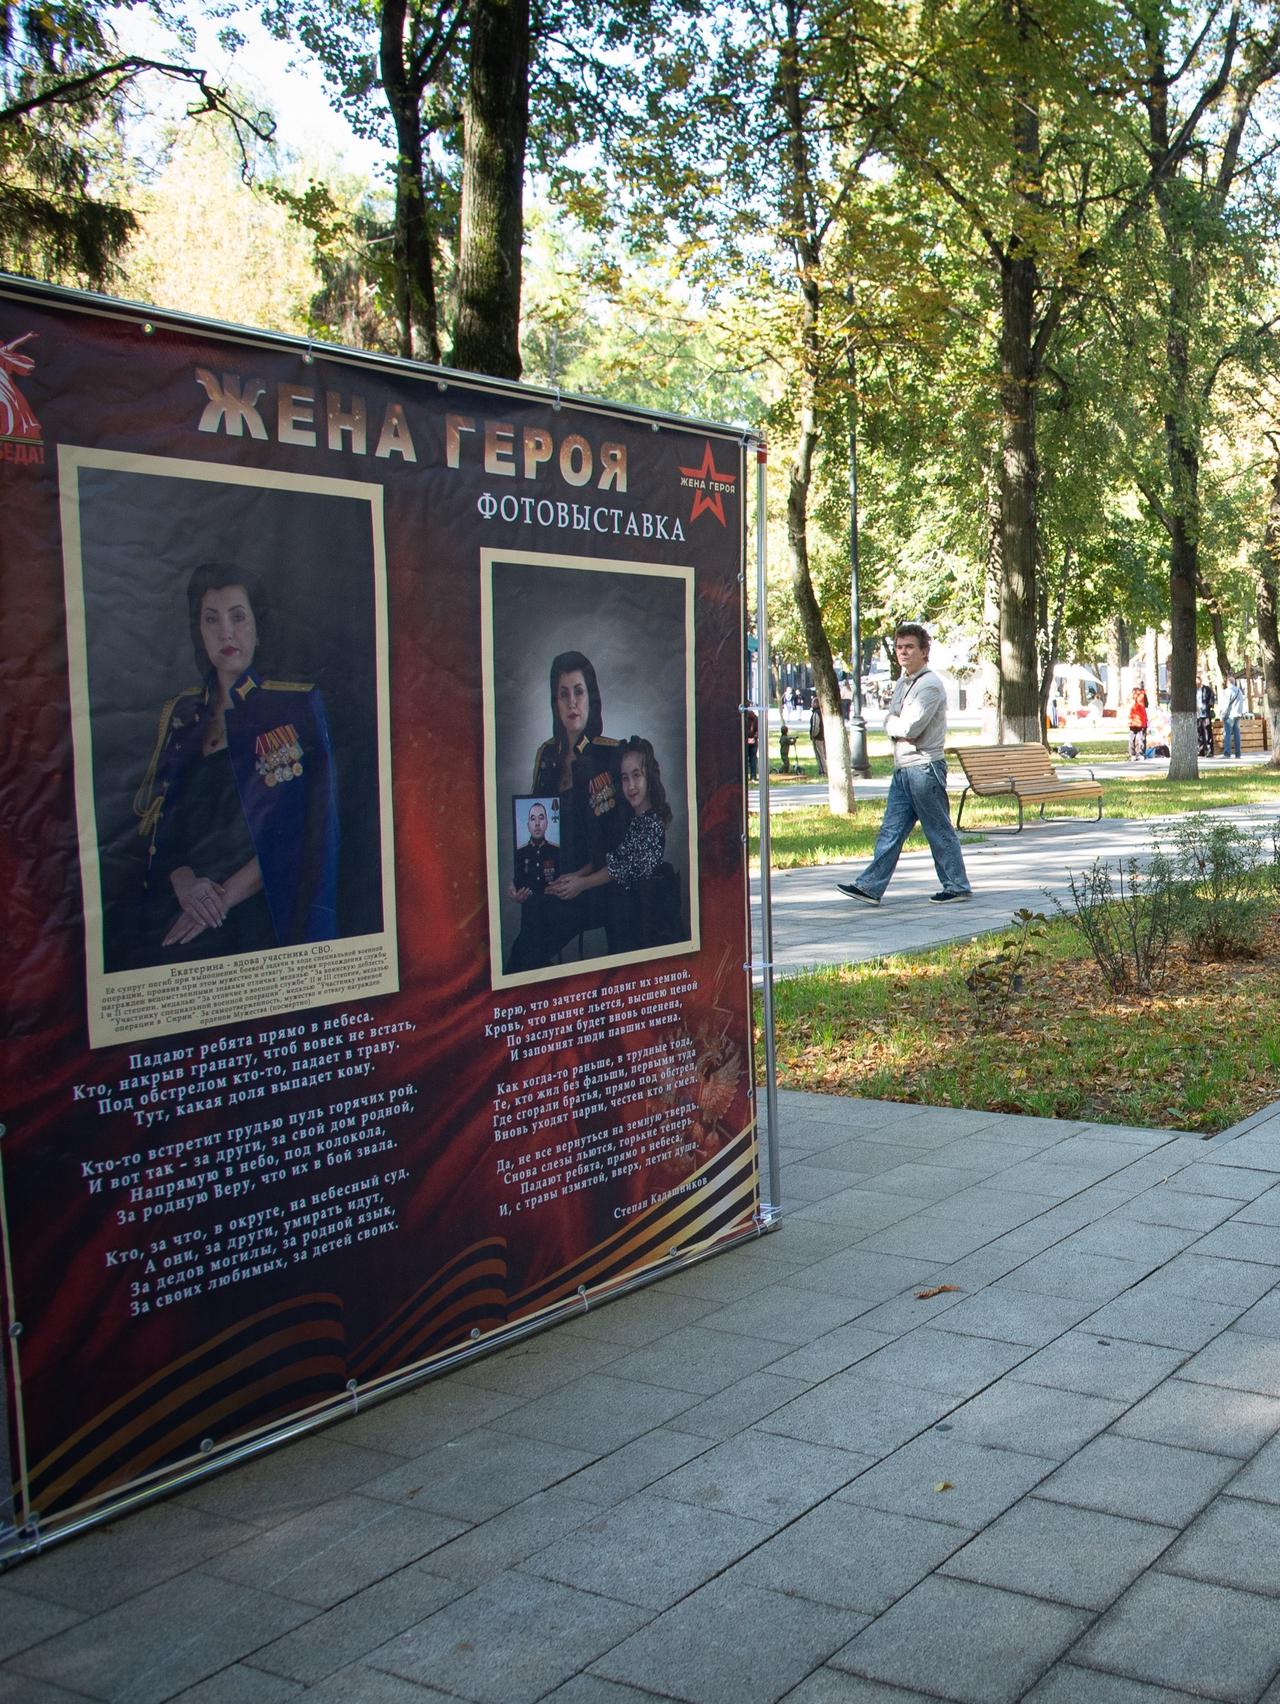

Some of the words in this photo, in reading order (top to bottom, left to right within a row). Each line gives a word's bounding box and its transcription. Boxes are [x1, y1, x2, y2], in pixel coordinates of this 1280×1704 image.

[195, 367, 417, 462] ЖЕНА
[445, 415, 629, 493] ГЕРОЯ
[680, 476, 706, 489] ЖЕНА
[709, 481, 735, 494] ГЕРОЯ
[477, 492, 687, 542] ФОТОВЫСТАВКА
[116, 983, 145, 993] супруг
[170, 963, 224, 977] Екатерина
[233, 957, 259, 966] вдова
[262, 950, 308, 963] участника
[527, 1015, 546, 1026] что
[549, 1006, 584, 1022] нынче
[627, 988, 666, 1004] высшею
[669, 980, 697, 995] ценой
[529, 999, 548, 1010] что
[552, 989, 597, 1006] зачтется
[600, 980, 636, 996] подвиг
[639, 978, 651, 988] их
[128, 1047, 194, 1069] Падают
[199, 1035, 253, 1059] ребята
[258, 1025, 305, 1045] прямо
[311, 1022, 318, 1032] в
[323, 1012, 373, 1030] небеса.
[506, 1034, 521, 1047] По
[524, 1023, 572, 1042] заслугам
[576, 1015, 606, 1032] будет
[608, 1009, 638, 1023] вновь
[509, 1048, 519, 1061] И
[522, 1038, 573, 1058] запомнят
[576, 1030, 604, 1045] люди
[608, 1020, 645, 1037] павших
[72, 1084, 112, 1100] Кто,
[119, 1067, 184, 1090] накрыв
[190, 1053, 257, 1078] гранату,
[263, 1040, 297, 1059] чтоб
[302, 1034, 343, 1051] вовек
[348, 1030, 364, 1042] не
[369, 1020, 416, 1037] встать,
[98, 1097, 133, 1114] Под
[139, 1076, 226, 1105] обстрелом
[232, 1064, 286, 1084] кто-то,
[291, 1051, 340, 1071] падает
[344, 1049, 352, 1059] в
[356, 1040, 399, 1059] траву.
[133, 1109, 169, 1127] Тут,
[176, 1095, 222, 1116] какая
[228, 1086, 264, 1105] доля
[270, 1070, 332, 1093] выпадет
[337, 1062, 375, 1078] кому.
[81, 1153, 140, 1176] Кто-то
[147, 1132, 221, 1160] встретит
[227, 1117, 282, 1142] грудью
[288, 1107, 323, 1126] пуль
[328, 1092, 384, 1114] горячих
[388, 1083, 417, 1103] рой.
[88, 1177, 102, 1193] И
[110, 1171, 139, 1188] вот
[145, 1163, 173, 1179] так
[193, 1154, 209, 1167] за
[215, 1140, 266, 1163] други,
[271, 1134, 286, 1146] за
[291, 1122, 324, 1140] свой
[330, 1115, 355, 1133] дом
[360, 1100, 414, 1127] родной,
[503, 1166, 537, 1184] Снова
[541, 1155, 572, 1172] слезы
[619, 1127, 657, 1147] горькие
[518, 1153, 531, 1165] не
[535, 1147, 551, 1159] все
[555, 1129, 608, 1153] вернуться
[611, 1125, 623, 1135] на
[626, 1112, 661, 1131] земную
[116, 1209, 135, 1224] За
[143, 1191, 208, 1222] родную
[213, 1179, 255, 1198] Веру,
[260, 1169, 286, 1183] что
[291, 1162, 308, 1175] их
[313, 1159, 321, 1169] в
[326, 1148, 352, 1165] бой
[356, 1139, 397, 1157] звала.
[130, 1170, 218, 1202] Напрямую
[224, 1166, 233, 1176] в
[239, 1153, 279, 1173] небо,
[284, 1144, 311, 1160] под
[316, 1126, 385, 1152] колокола,
[515, 1201, 521, 1210] с
[524, 1189, 557, 1209] травы
[645, 1150, 672, 1166] летит
[520, 1173, 562, 1194] Падают
[606, 1148, 637, 1166] прямо
[640, 1145, 645, 1154] в
[105, 1248, 144, 1266] Кто,
[150, 1239, 166, 1253] за
[172, 1229, 207, 1245] что,
[214, 1224, 222, 1234] в
[229, 1206, 284, 1230] округе,
[289, 1198, 306, 1211] на
[311, 1174, 379, 1204] небесный
[384, 1168, 409, 1184] суд.
[613, 1199, 648, 1219] Степан
[650, 1177, 708, 1205] Кадашников
[130, 1281, 149, 1296] За
[156, 1264, 204, 1290] дедов
[210, 1244, 277, 1271] могилы,
[282, 1236, 296, 1249] за
[302, 1216, 352, 1246] родной
[357, 1205, 395, 1224] язык,
[144, 1258, 155, 1273] А
[163, 1249, 198, 1267] они,
[204, 1241, 220, 1254] за
[226, 1225, 278, 1250] други,
[283, 1204, 342, 1235] умирать
[347, 1192, 383, 1210] идут,
[130, 1300, 149, 1316] За
[155, 1283, 201, 1307] своих
[207, 1257, 287, 1290] любимых,
[293, 1249, 307, 1262] за
[312, 1233, 352, 1258] детей
[357, 1220, 398, 1240] своих.
